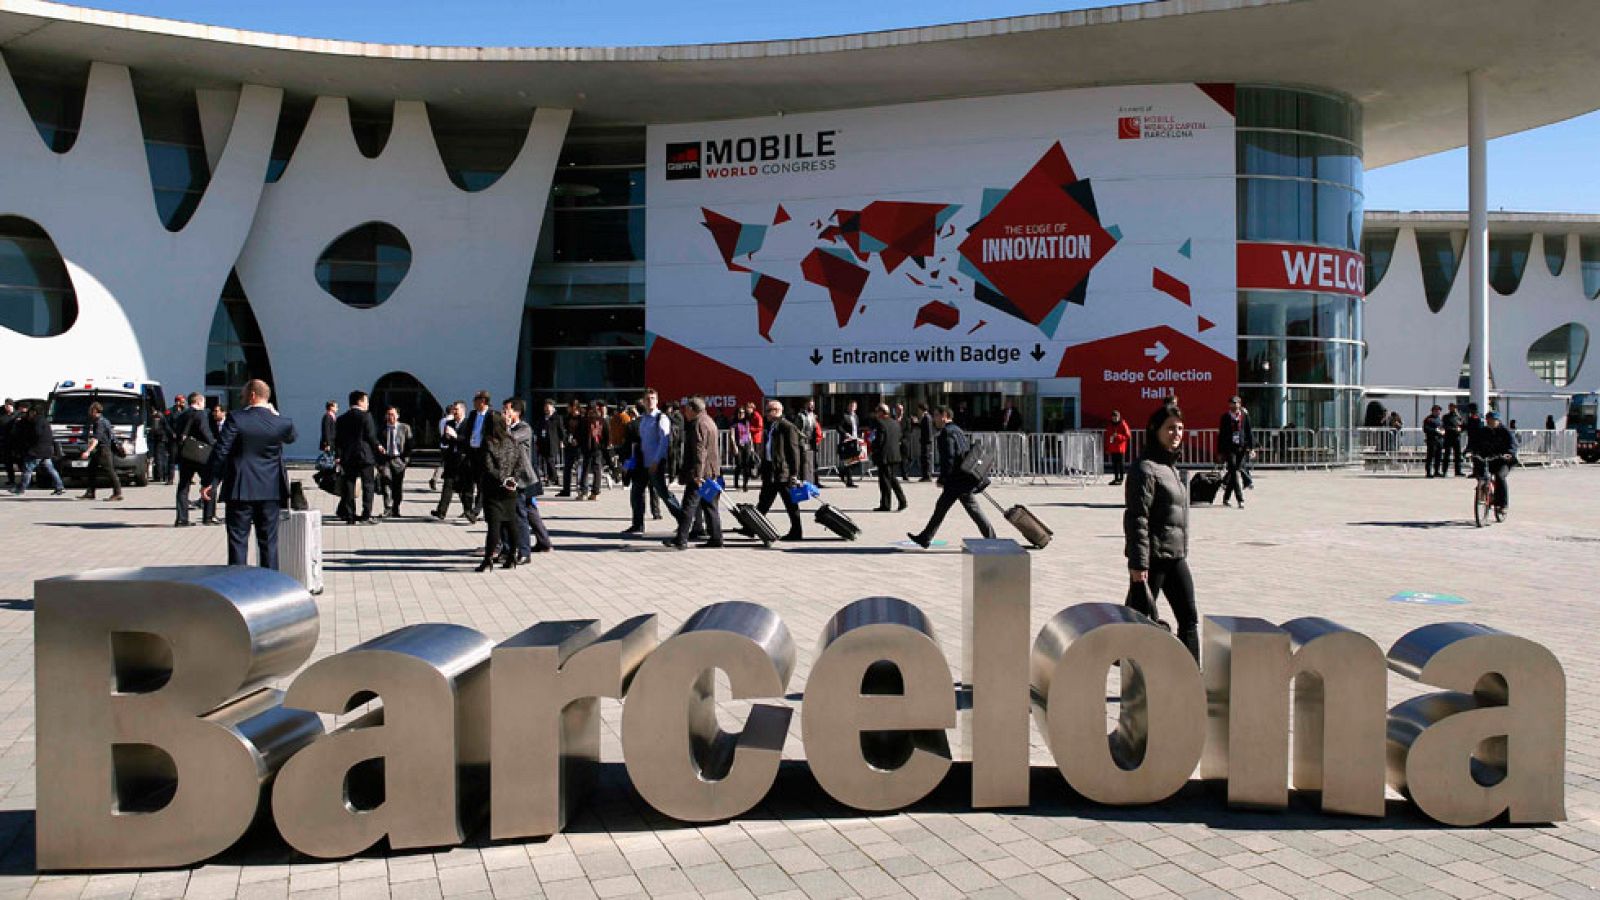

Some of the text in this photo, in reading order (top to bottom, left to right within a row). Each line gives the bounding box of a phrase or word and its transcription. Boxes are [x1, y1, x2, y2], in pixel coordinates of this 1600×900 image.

[706, 130, 836, 166] MOBILE
[706, 159, 837, 179] WORLD CONGRESS
[1005, 223, 1069, 235] THE EDGE OF
[982, 234, 1093, 264] INNOVATION
[1281, 250, 1365, 293] WELCO
[832, 344, 1022, 365] Entrance with Badge
[1103, 368, 1213, 383] Badge Collection
[1141, 387, 1166, 399] Hall
[35, 542, 1567, 870] Barcelona
